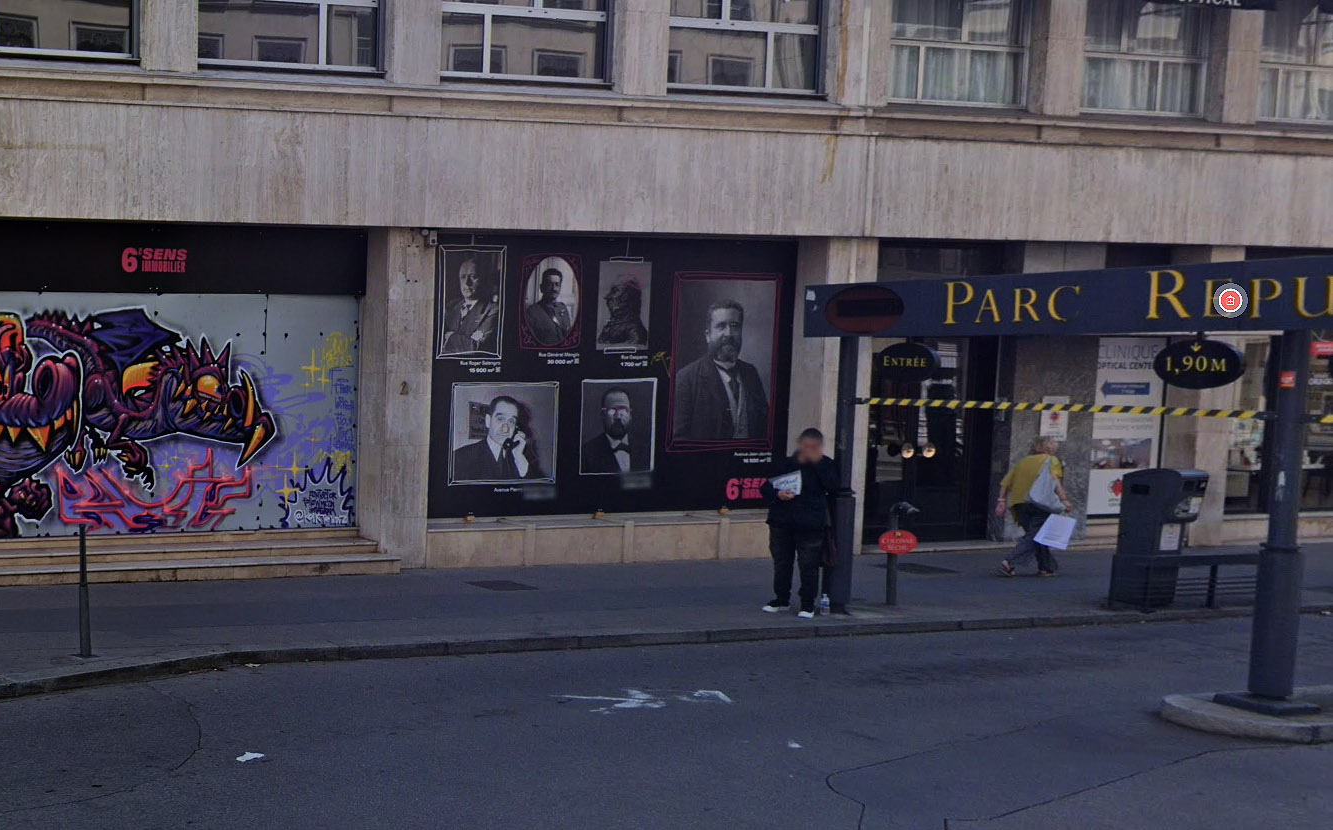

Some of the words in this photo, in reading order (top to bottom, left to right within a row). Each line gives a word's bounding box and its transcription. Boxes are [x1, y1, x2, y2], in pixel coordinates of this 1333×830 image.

[141, 260, 186, 273] IMMOBILIER
[943, 281, 1081, 325] PARC
[883, 354, 928, 368] ENTRÉE
[1129, 361, 1154, 370] CENTE
